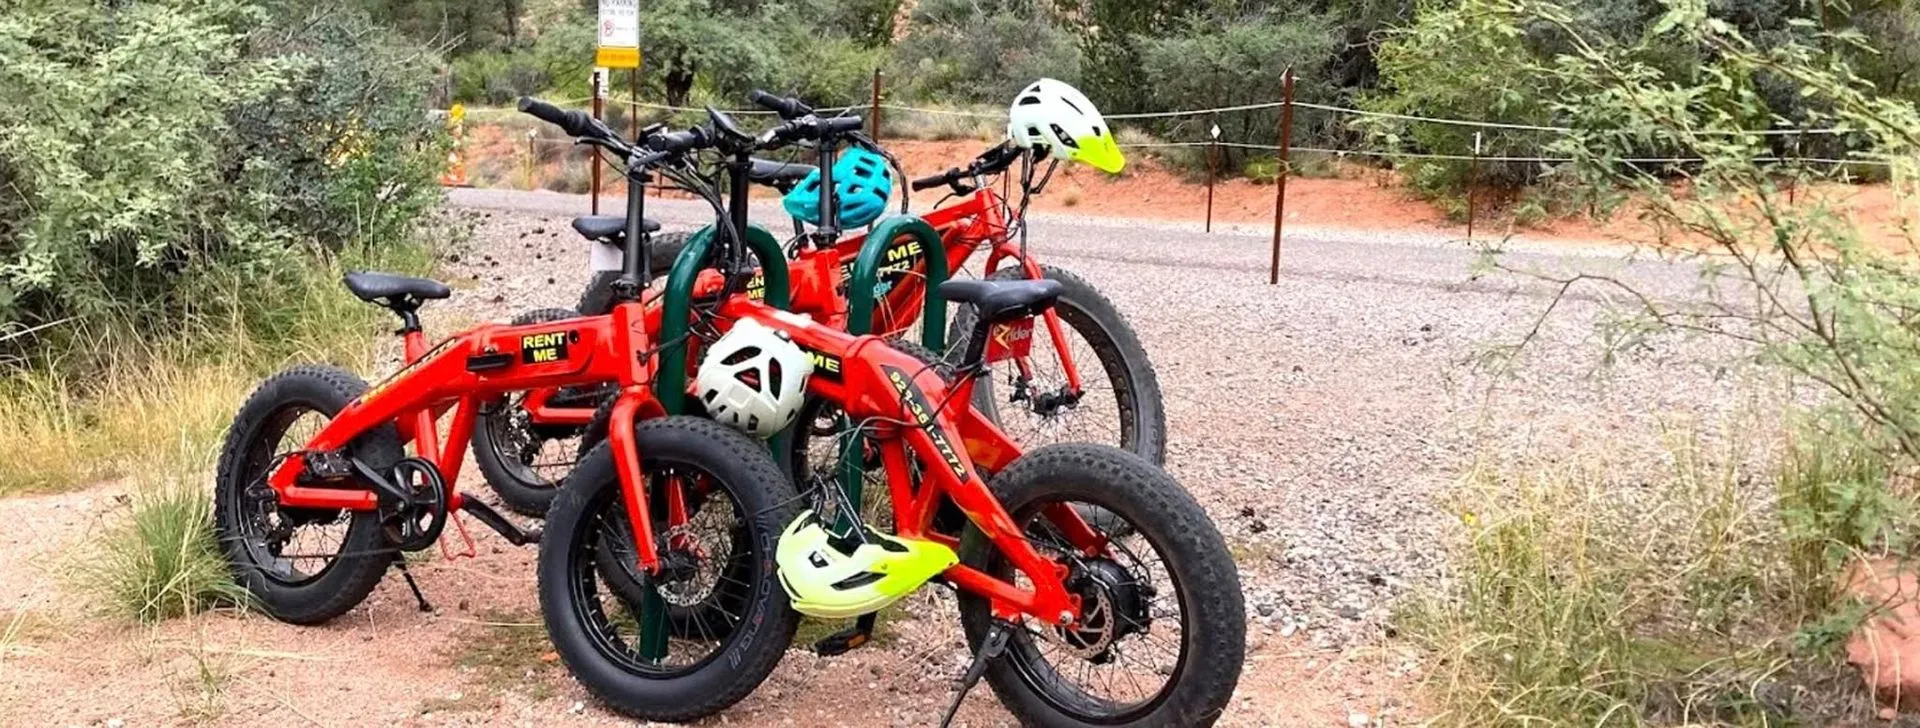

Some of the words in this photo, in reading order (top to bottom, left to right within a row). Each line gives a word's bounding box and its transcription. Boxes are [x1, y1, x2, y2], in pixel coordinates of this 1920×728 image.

[887, 241, 922, 262] ME
[523, 332, 565, 349] RENT
[533, 348, 558, 362] ME
[806, 351, 840, 373] ME
